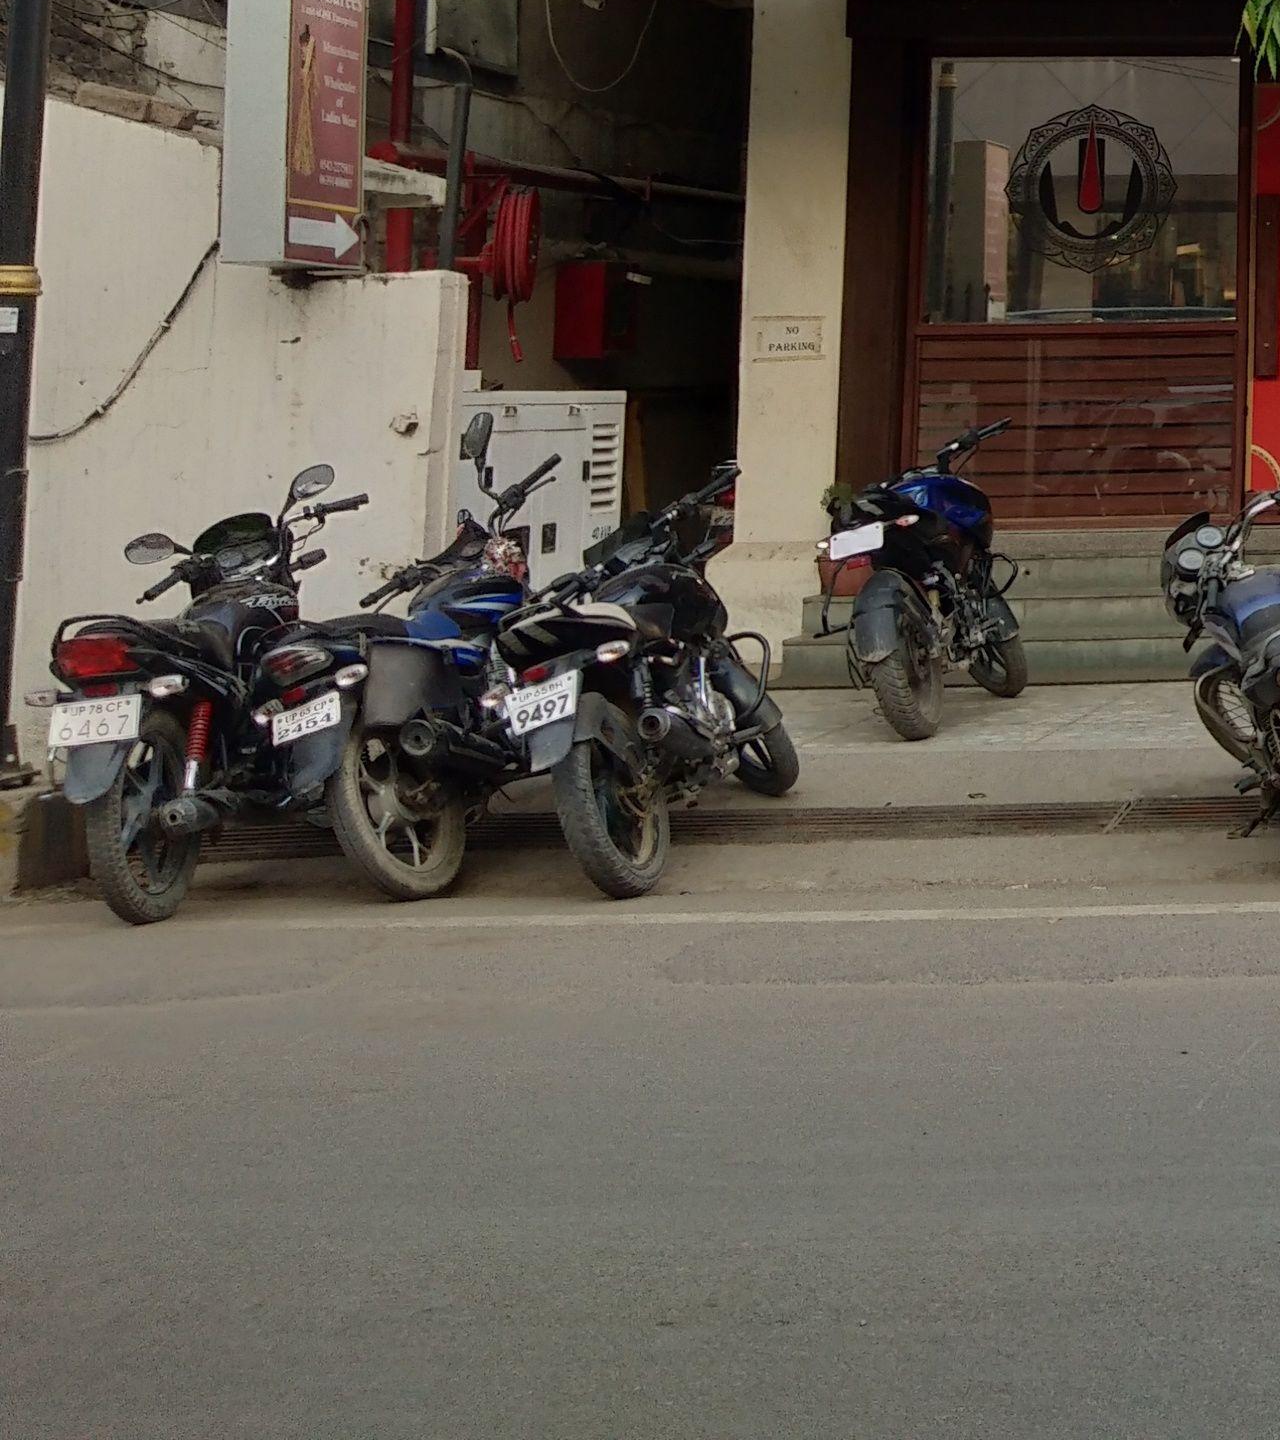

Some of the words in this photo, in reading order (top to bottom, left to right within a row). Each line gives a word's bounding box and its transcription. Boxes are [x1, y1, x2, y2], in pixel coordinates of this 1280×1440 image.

[786, 326, 799, 335] NO
[768, 342, 815, 351] PARKING
[517, 694, 569, 728] 9497
[59, 715, 129, 740] 6467
[278, 713, 333, 740] 2454
